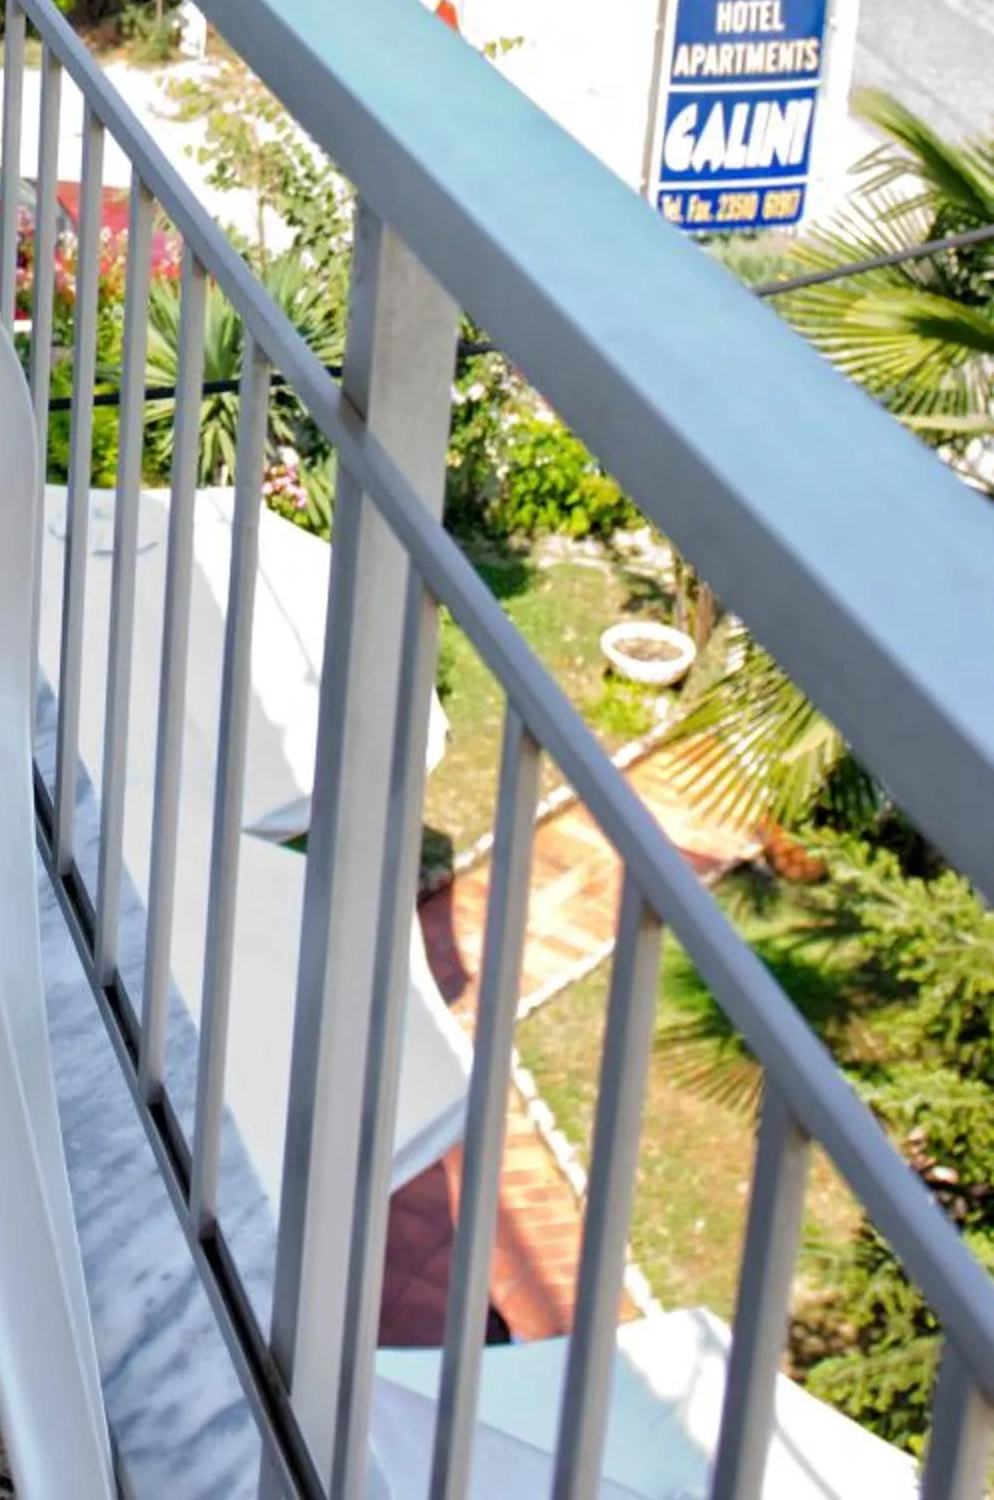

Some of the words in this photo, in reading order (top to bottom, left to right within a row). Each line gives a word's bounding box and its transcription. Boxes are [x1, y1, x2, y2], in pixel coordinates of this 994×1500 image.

[715, 0, 785, 33] HOTEL
[672, 39, 819, 77] APARTMENTS
[664, 97, 814, 174] GALINI
